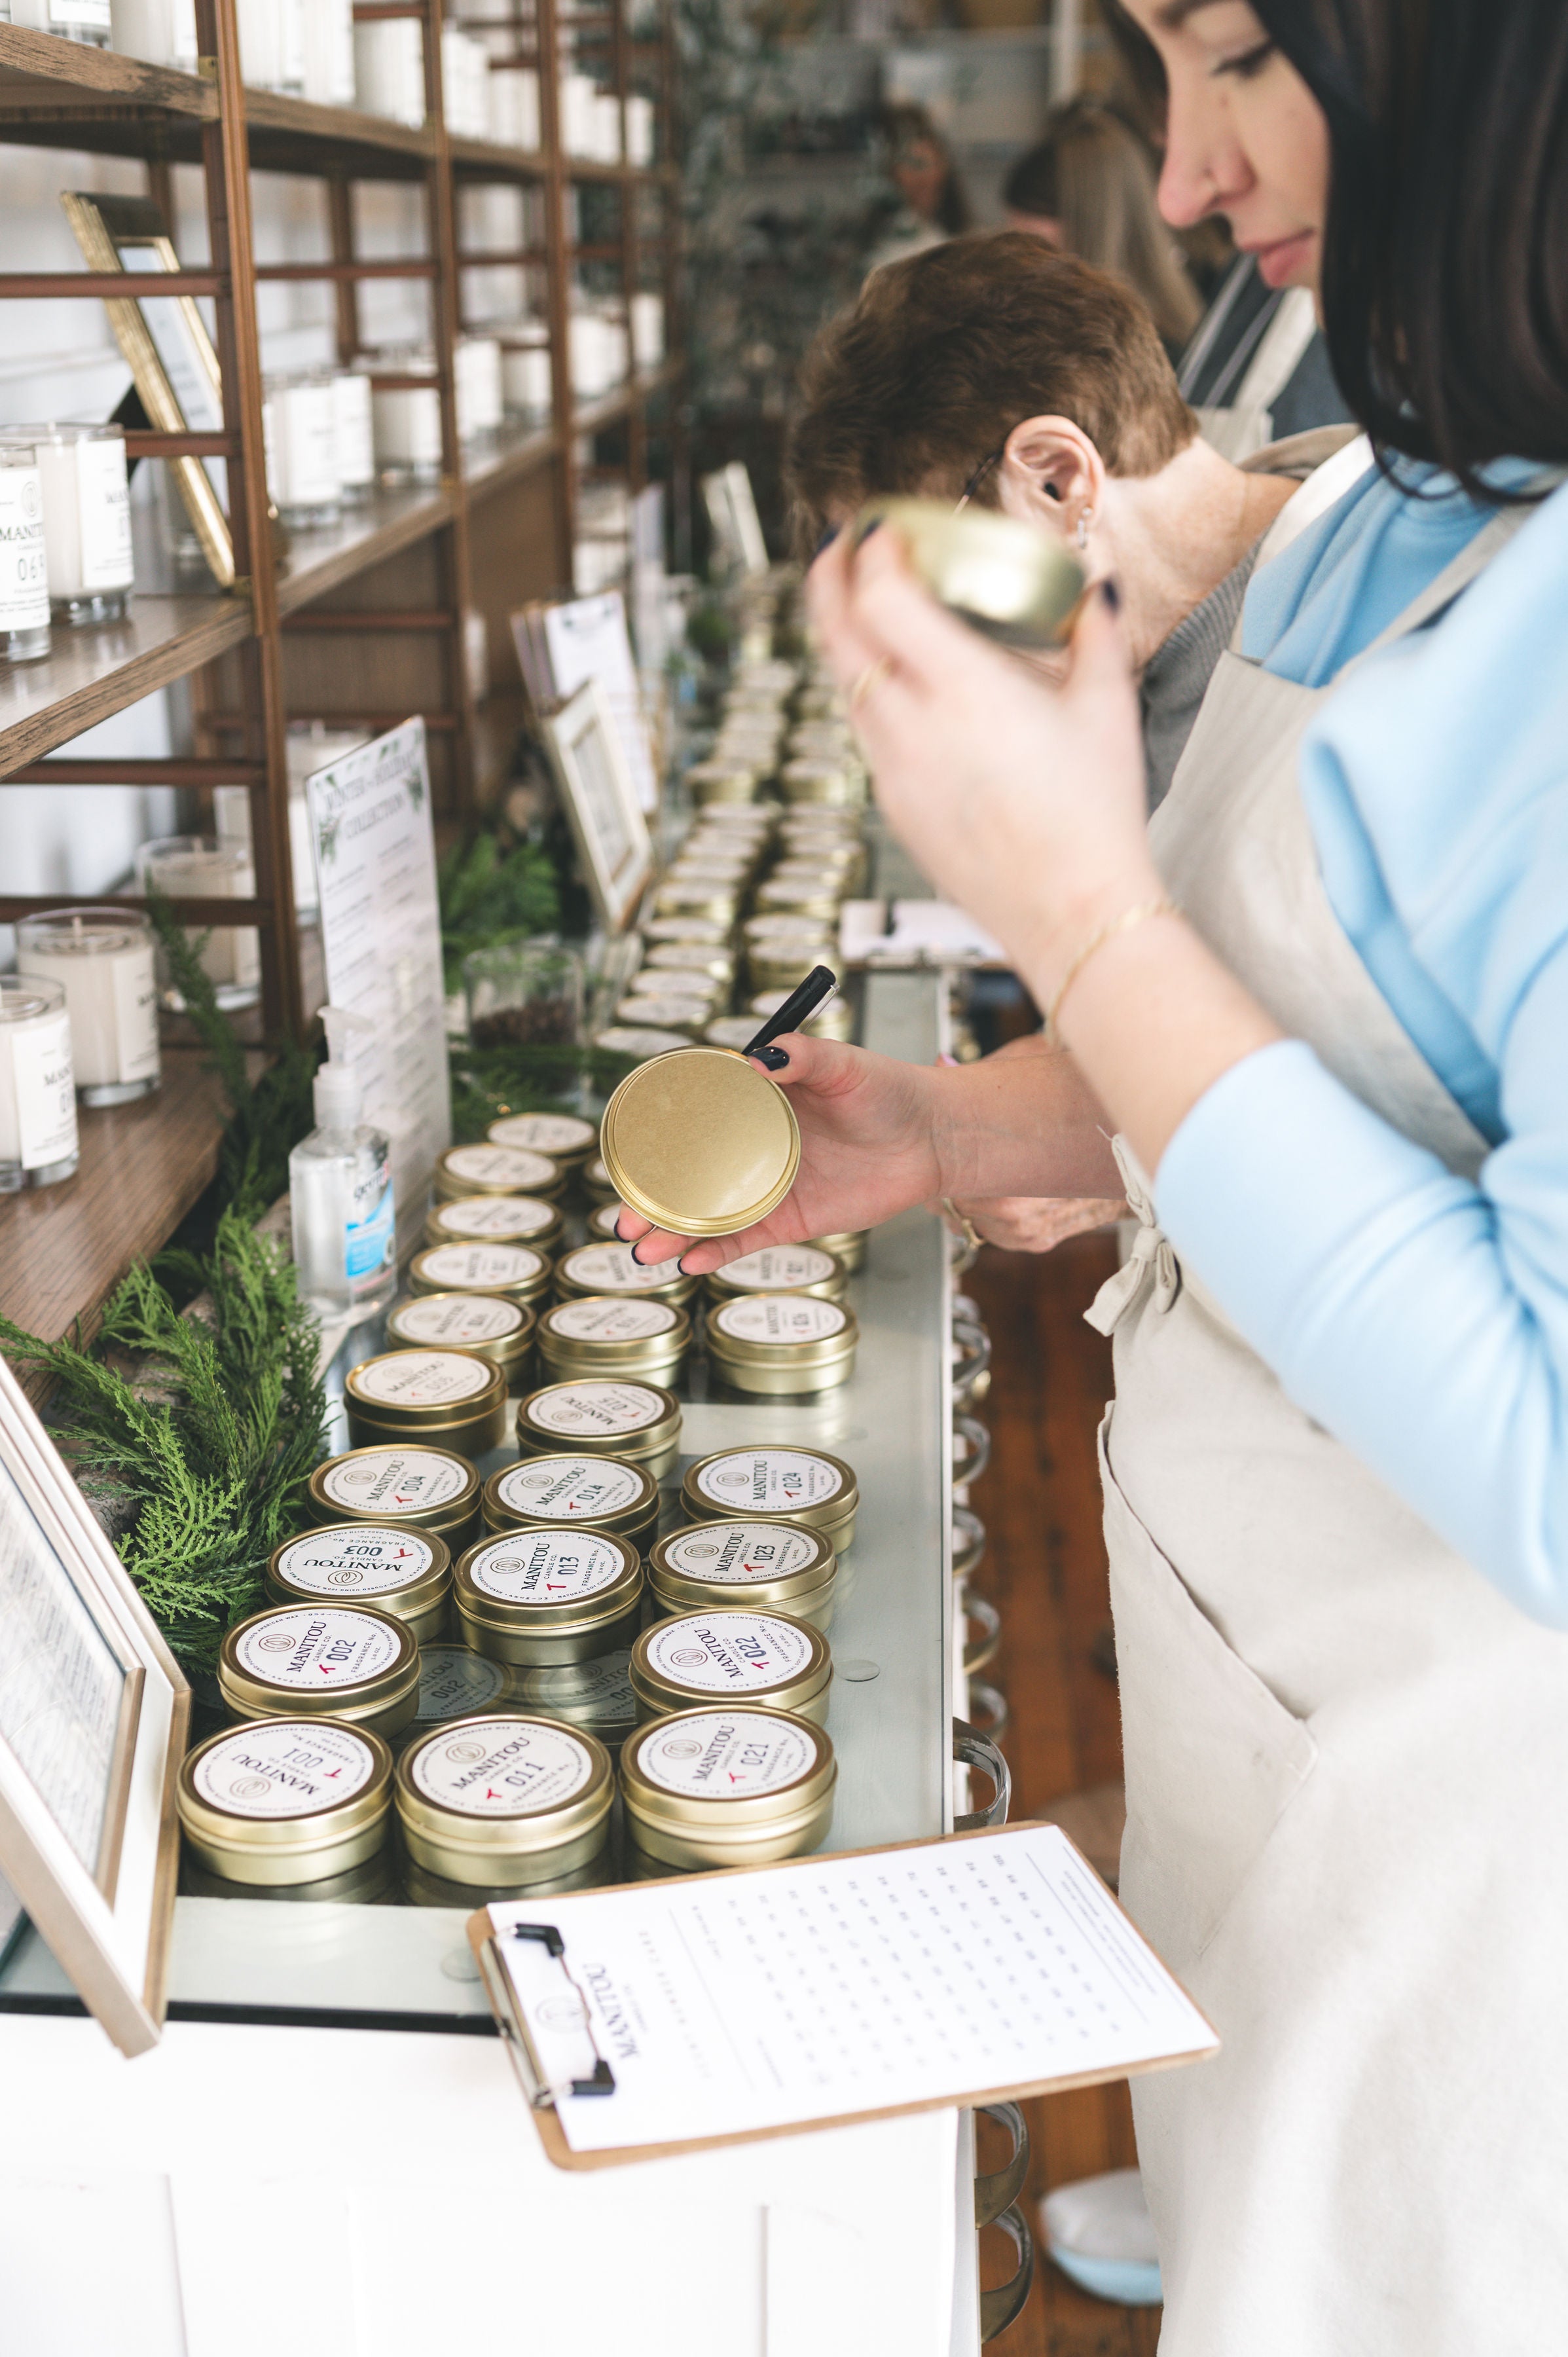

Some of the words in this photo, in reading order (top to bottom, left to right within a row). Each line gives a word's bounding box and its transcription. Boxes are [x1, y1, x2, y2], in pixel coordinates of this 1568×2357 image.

[367, 1461, 404, 1500] MANITOU
[401, 1476, 426, 1491] 004
[422, 1477, 443, 1501] FRAGRANCE
[536, 1467, 585, 1505] MANITOU
[753, 1461, 767, 1499] MANITOU
[782, 1472, 802, 1488] 024
[576, 1485, 605, 1500] 014
[590, 1487, 617, 1509] FRAGRANCE
[344, 1546, 382, 1556] 003
[715, 1533, 744, 1571] MANITOU
[738, 1549, 748, 1563] CANDLE
[753, 1545, 775, 1560] 023
[775, 1546, 790, 1569] FRAGRANCE
[304, 1560, 402, 1571] MANITOU
[521, 1543, 549, 1590] MANITOU
[544, 1563, 555, 1579] CANDLE
[558, 1557, 579, 1575] 013
[582, 1558, 596, 1586] FRAGRANCE
[287, 1622, 326, 1672] MANITOU
[313, 1644, 327, 1661] CANDLE
[326, 1640, 356, 1660] 002
[351, 1643, 371, 1672] FRAGRANCE
[695, 1630, 743, 1677] MANITOU
[729, 1646, 745, 1663] CANDLE
[735, 1636, 766, 1658] 022
[764, 1634, 791, 1662] FRAGRANCE
[431, 1680, 465, 1699] 002
[283, 1748, 323, 1767] 001
[452, 1738, 530, 1789] MANITOU
[693, 1726, 735, 1780] MANITOU
[740, 1744, 769, 1764] 021
[232, 1755, 318, 1794] MANITOU
[505, 1763, 544, 1786] 011
